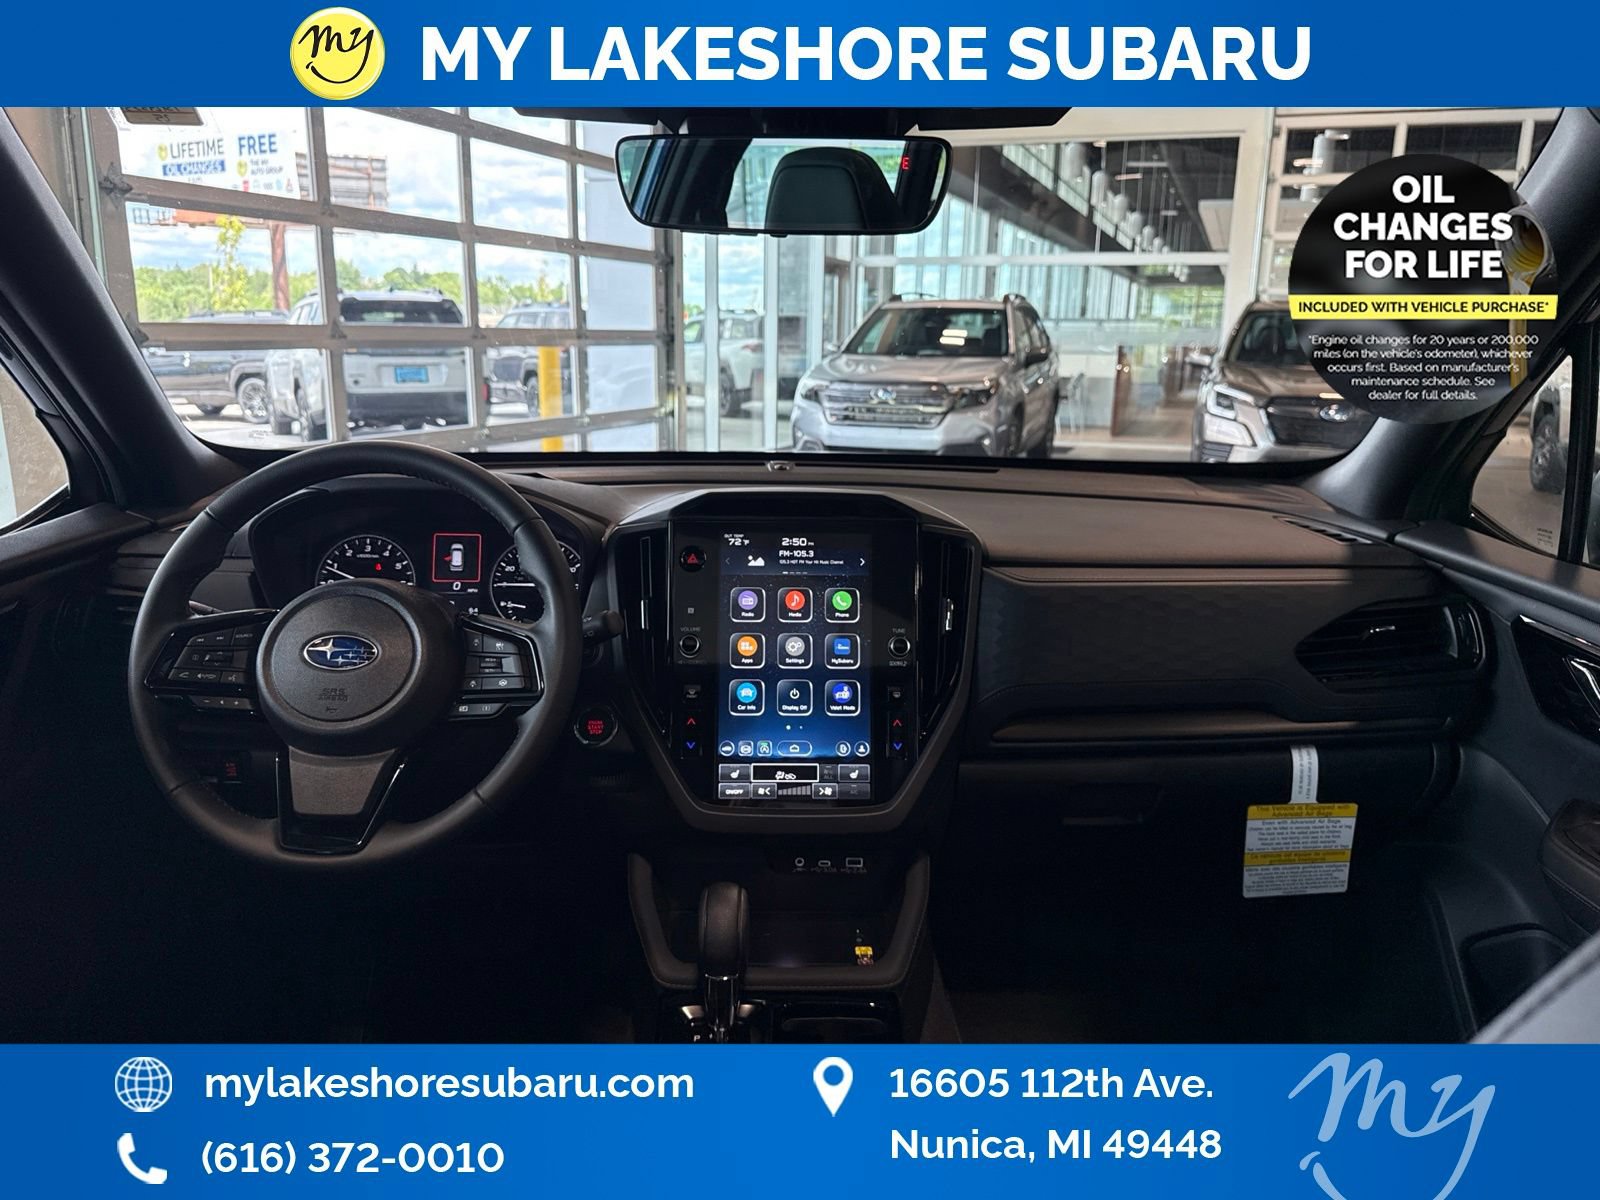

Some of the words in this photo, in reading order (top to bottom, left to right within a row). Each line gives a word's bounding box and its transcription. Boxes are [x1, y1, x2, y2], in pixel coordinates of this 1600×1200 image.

[170, 138, 224, 159] LIFETIME
[238, 133, 277, 156] FREE
[728, 538, 742, 546] 72
[781, 537, 807, 546] 2:50
[345, 549, 353, 557] 2
[778, 550, 815, 558] FM-105.3
[394, 562, 402, 570] 5
[452, 581, 462, 591] 0
[782, 704, 799, 712] Display
